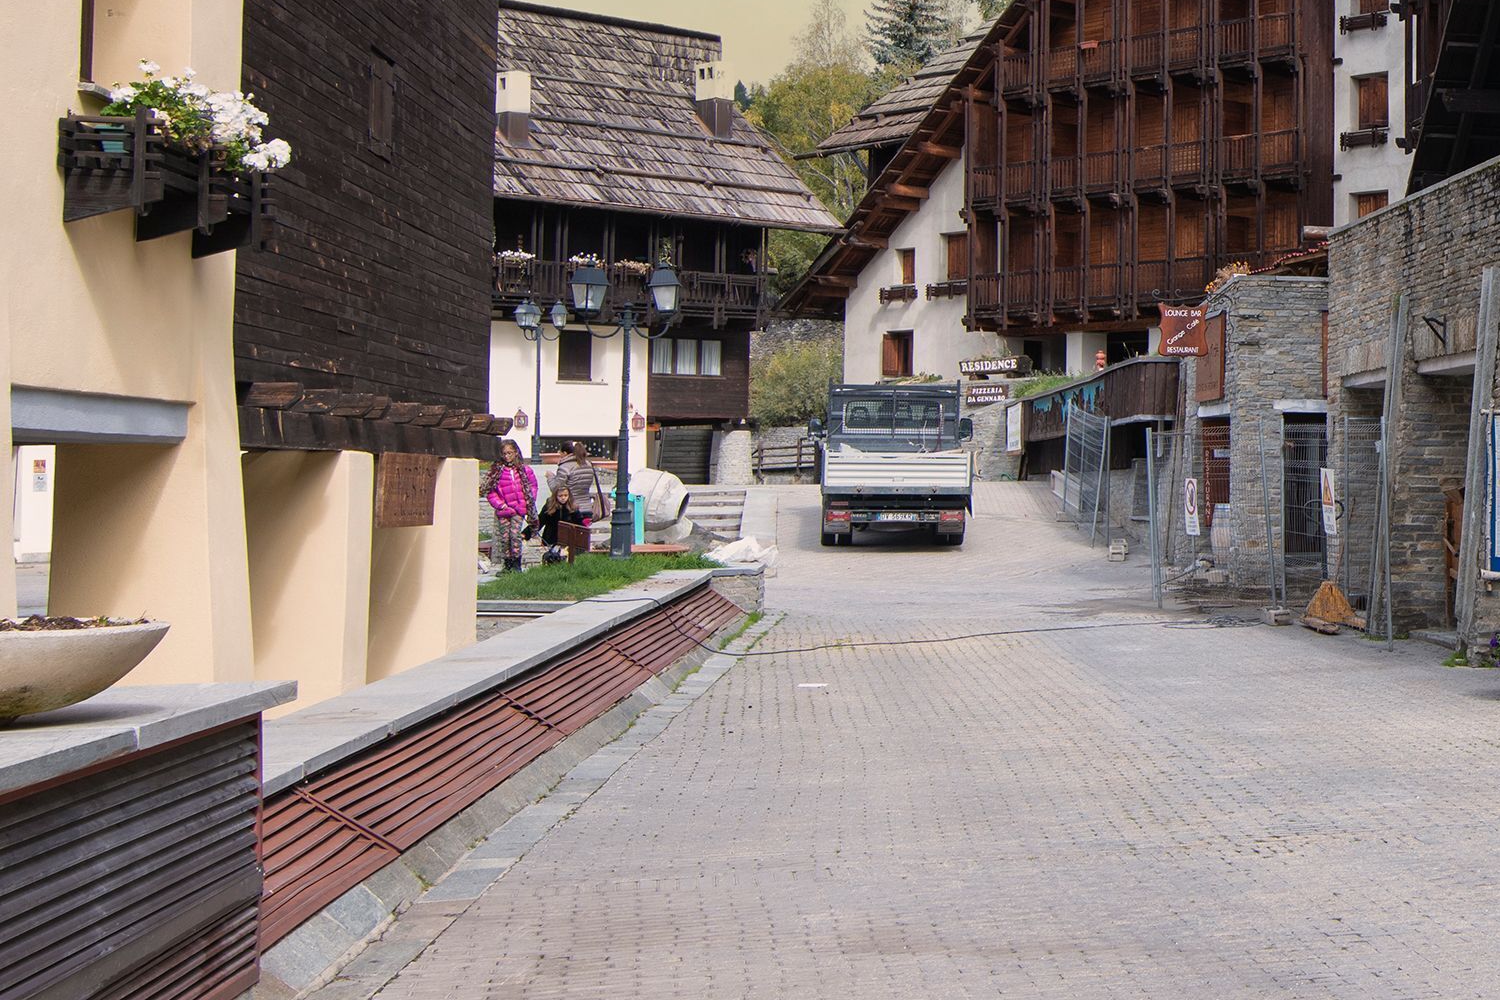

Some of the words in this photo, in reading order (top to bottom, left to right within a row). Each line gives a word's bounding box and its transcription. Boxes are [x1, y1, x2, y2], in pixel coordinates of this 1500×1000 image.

[1164, 309, 1188, 317] LOUNGE
[1166, 346, 1199, 354] RESTAURANT
[961, 359, 1017, 372] RESIDENCE
[972, 387, 1003, 395] PIZZERIA
